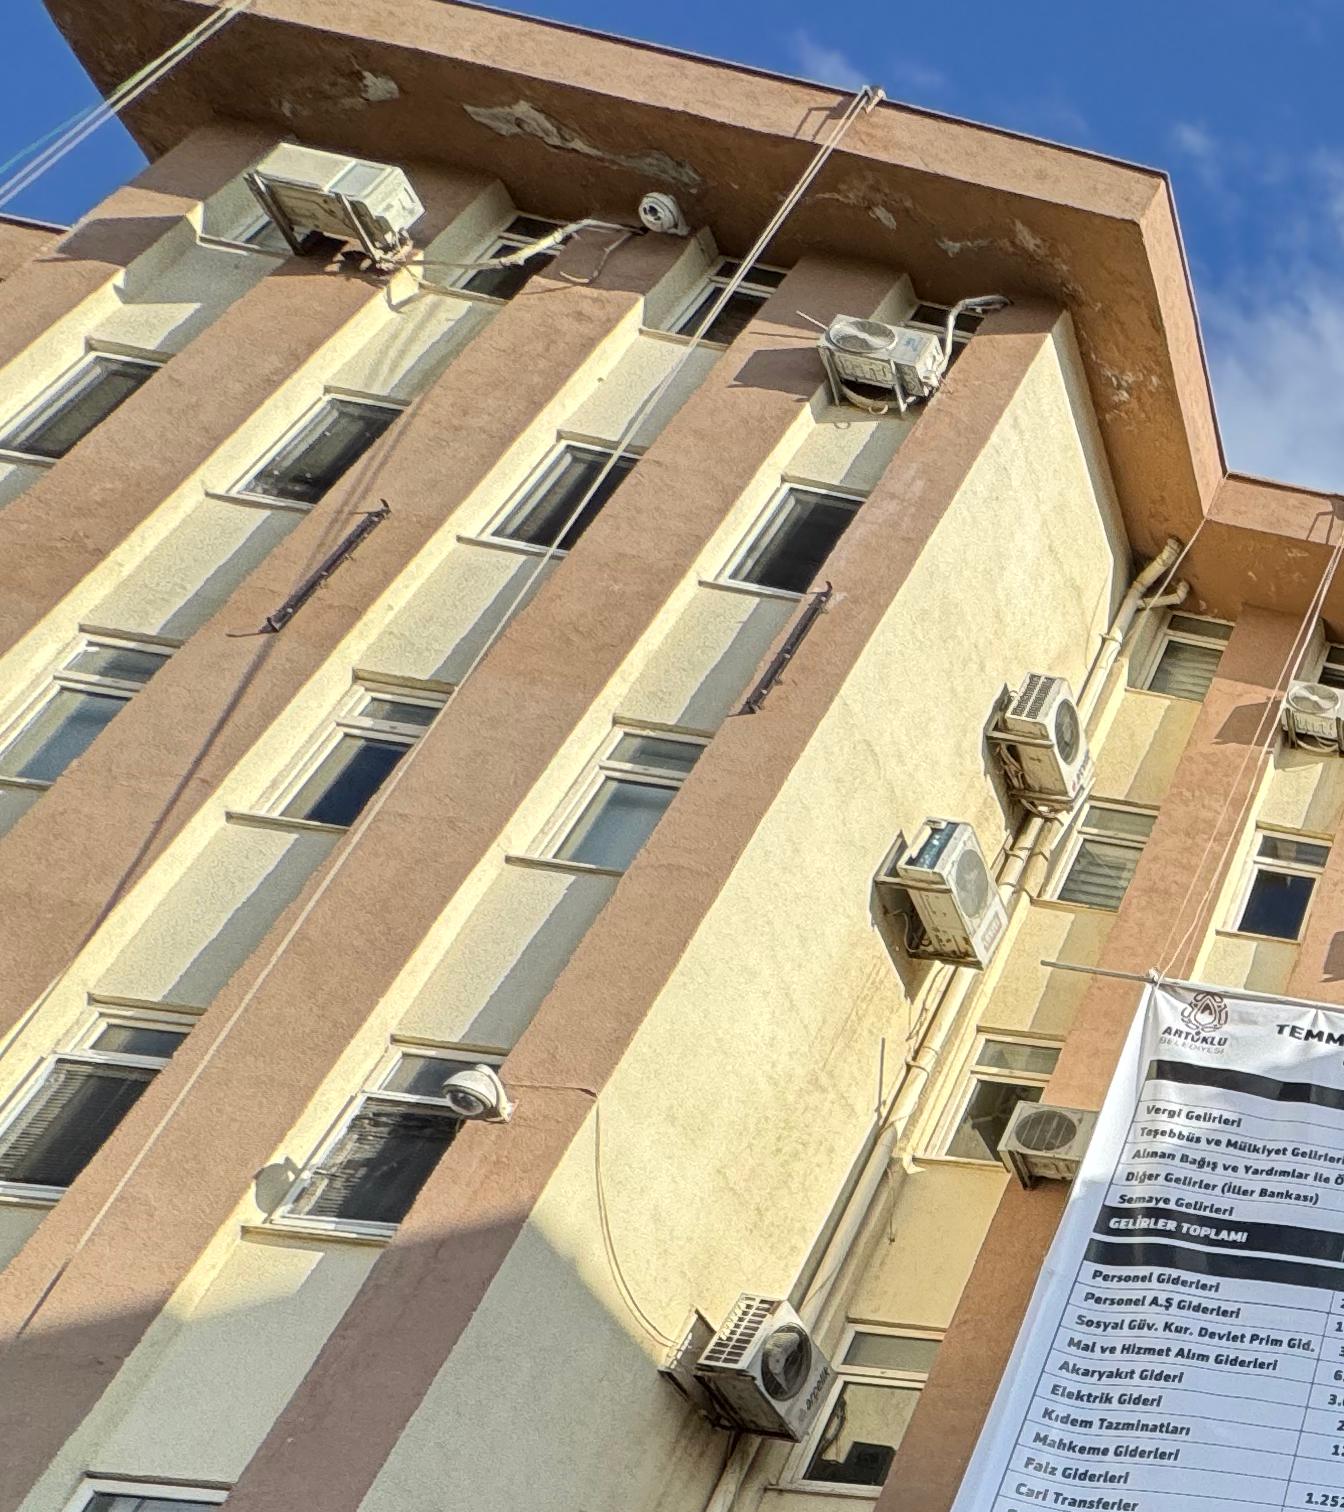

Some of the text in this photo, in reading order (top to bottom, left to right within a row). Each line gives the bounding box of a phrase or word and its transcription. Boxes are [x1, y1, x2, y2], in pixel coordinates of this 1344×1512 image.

[1146, 1105, 1182, 1120] Vergi
[1186, 1111, 1242, 1128] Gelirleri
[1140, 1127, 1201, 1144] Teşebbüs
[1207, 1137, 1222, 1146] ve
[1226, 1139, 1288, 1158] Mülkiyet
[1180, 1153, 1218, 1171] Bağış
[1223, 1163, 1238, 1172] ve
[1243, 1165, 1311, 1181] Yardımlar
[1125, 1171, 1160, 1184] Diğer
[1164, 1173, 1218, 1191] Gelirler
[1221, 1181, 1256, 1198] (İller
[1259, 1187, 1320, 1205] Bankası)
[1118, 1194, 1171, 1206] Semaye
[1175, 1197, 1234, 1216] Gelirleri
[1109, 1216, 1177, 1231] GELİRLER
[1181, 1223, 1248, 1243] TOPLAMI
[1092, 1270, 1152, 1283] Personel
[1157, 1273, 1220, 1293] Giderleri
[1084, 1292, 1145, 1306] Personel
[1150, 1297, 1173, 1311] A.Ş
[1177, 1299, 1241, 1319] Giderleri
[1075, 1314, 1124, 1331] Sosyal
[1129, 1320, 1158, 1332] Güv.
[1163, 1322, 1193, 1336] Kur.
[1198, 1327, 1246, 1343] Devlet
[1249, 1333, 1283, 1348] Prim
[1288, 1338, 1315, 1352] Gid.
[1067, 1337, 1096, 1354] Mal
[1100, 1344, 1117, 1355] ve
[1120, 1343, 1171, 1358] Hizmet
[1174, 1349, 1209, 1364] Alım
[1214, 1351, 1278, 1371] Giderleri
[1058, 1360, 1135, 1381] Akaryakıt
[1140, 1368, 1184, 1383] Gideri
[1051, 1384, 1113, 1405] Elektrik
[1117, 1392, 1163, 1408] Gideri
[1042, 1407, 1093, 1429] Kıdem
[1099, 1418, 1190, 1436] Tazminatları
[1033, 1432, 1109, 1457] Mahkeme
[1114, 1445, 1180, 1461] Giderleri
[1024, 1456, 1057, 1476] Faiz
[1062, 1467, 1129, 1484] Giderleri
[1015, 1482, 1049, 1501] Cari
[1053, 1492, 1139, 1512] Transferler
